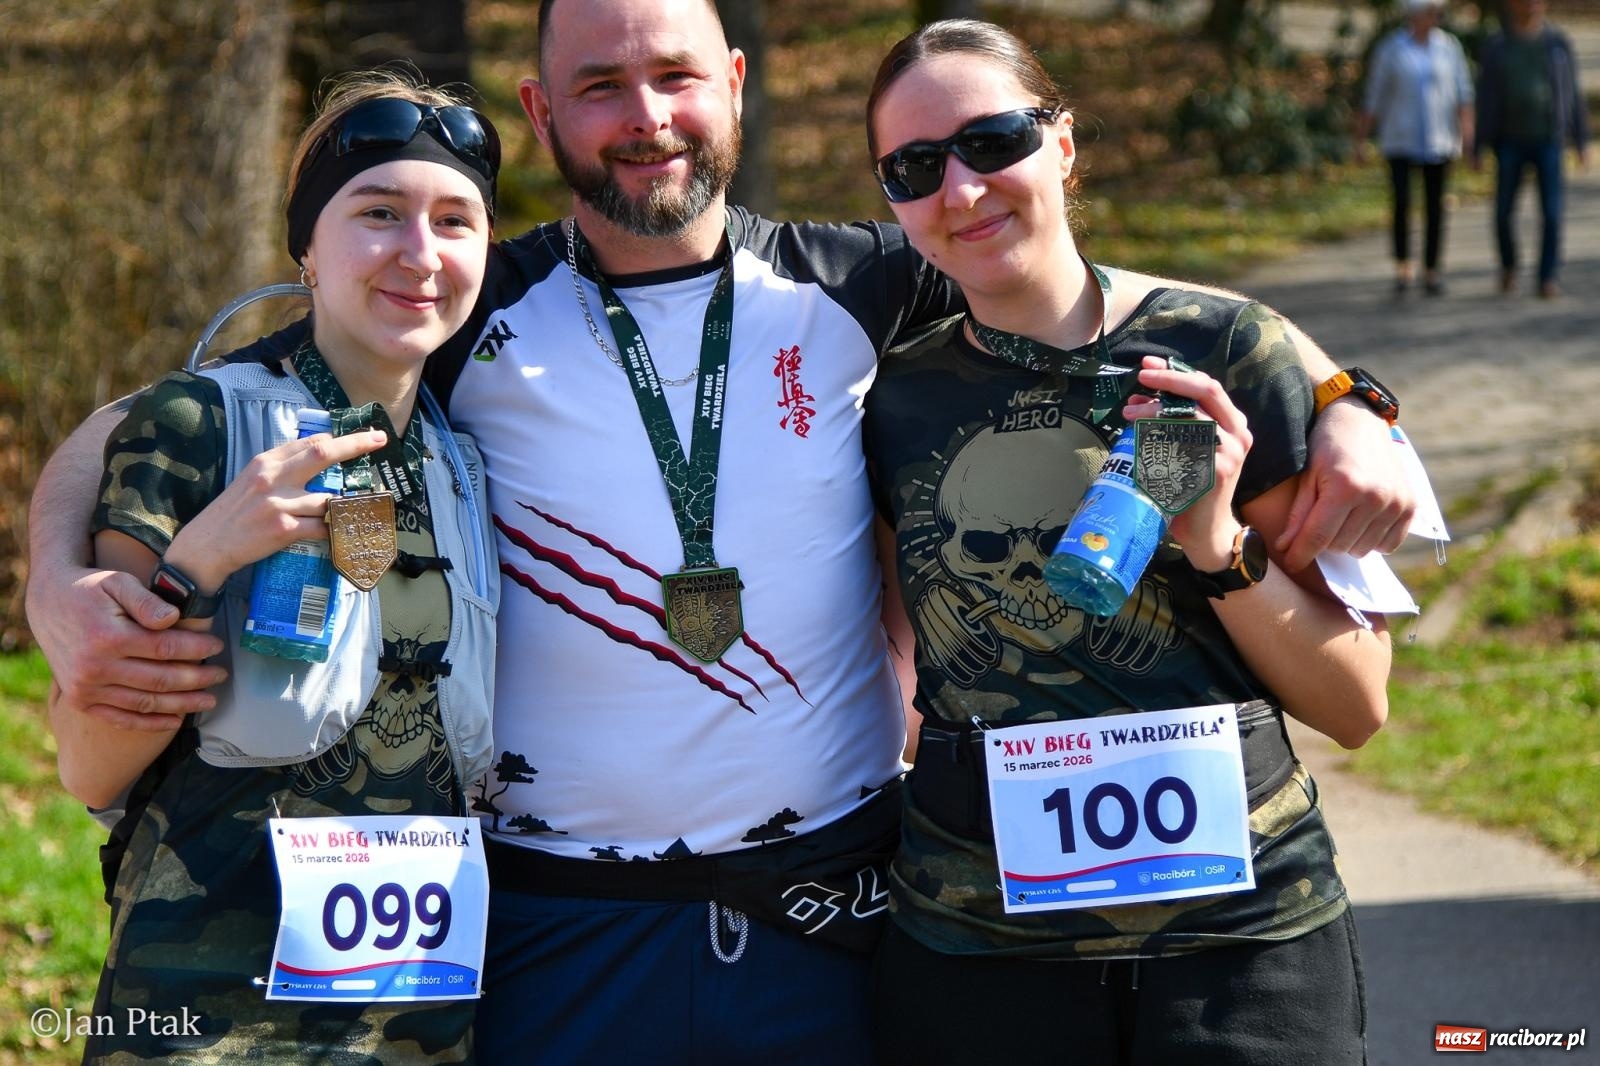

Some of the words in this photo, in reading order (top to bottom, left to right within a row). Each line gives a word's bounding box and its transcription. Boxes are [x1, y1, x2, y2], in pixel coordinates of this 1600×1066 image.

[626, 346, 641, 369] BIEG
[633, 334, 662, 398] TWARDZIELA
[634, 367, 648, 389] XIV
[703, 374, 714, 397] BIEG
[701, 397, 712, 418] XIV
[711, 364, 726, 430] TWARDZIELA
[1001, 406, 1061, 431] HERO
[394, 466, 407, 482] XIV
[1003, 737, 1036, 757] XIV
[1045, 732, 1092, 753] BIEG
[1099, 720, 1222, 748] TWARDZIELA
[1003, 762, 1017, 773] 15
[1018, 758, 1061, 771] marzec
[1063, 754, 1094, 767] 2026
[1042, 775, 1198, 854] 100
[289, 831, 320, 849] XIV
[327, 831, 369, 849] BIEG
[375, 830, 470, 848] TWARDZIELA
[292, 854, 304, 864] 15
[306, 853, 343, 864] marzec
[345, 852, 370, 864] 2026
[1152, 868, 1197, 881] Racibórz
[1205, 864, 1226, 876] OSiR
[322, 881, 453, 952] 099
[405, 974, 441, 985] Racibórz
[447, 974, 464, 984] OSiR
